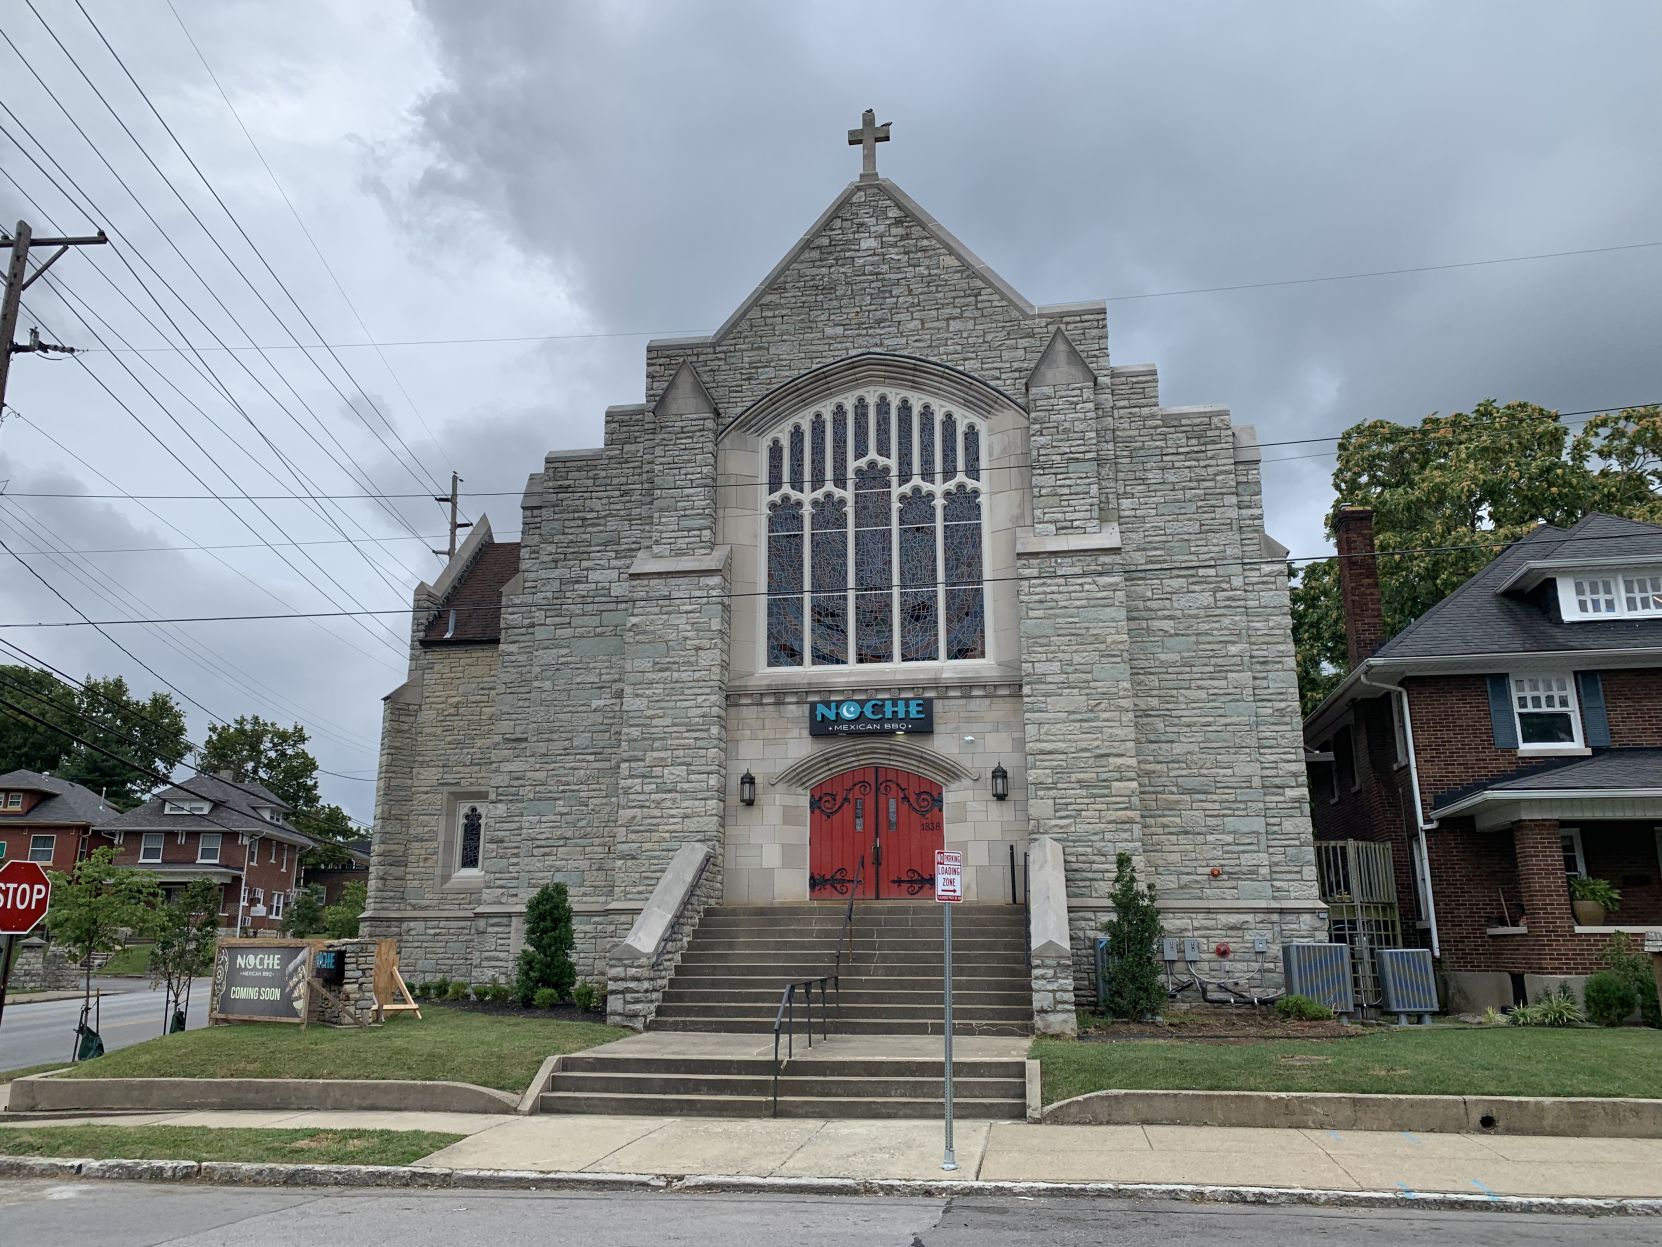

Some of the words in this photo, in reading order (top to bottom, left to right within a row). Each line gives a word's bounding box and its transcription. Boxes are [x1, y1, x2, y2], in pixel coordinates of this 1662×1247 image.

[816, 700, 926, 721] NOCHE
[944, 854, 961, 863] PARKING
[938, 866, 961, 876] LOADING
[942, 877, 956, 887] ZONE
[236, 954, 281, 969] NOCHE
[230, 986, 259, 999] COMING
[260, 987, 281, 1000] SOON
